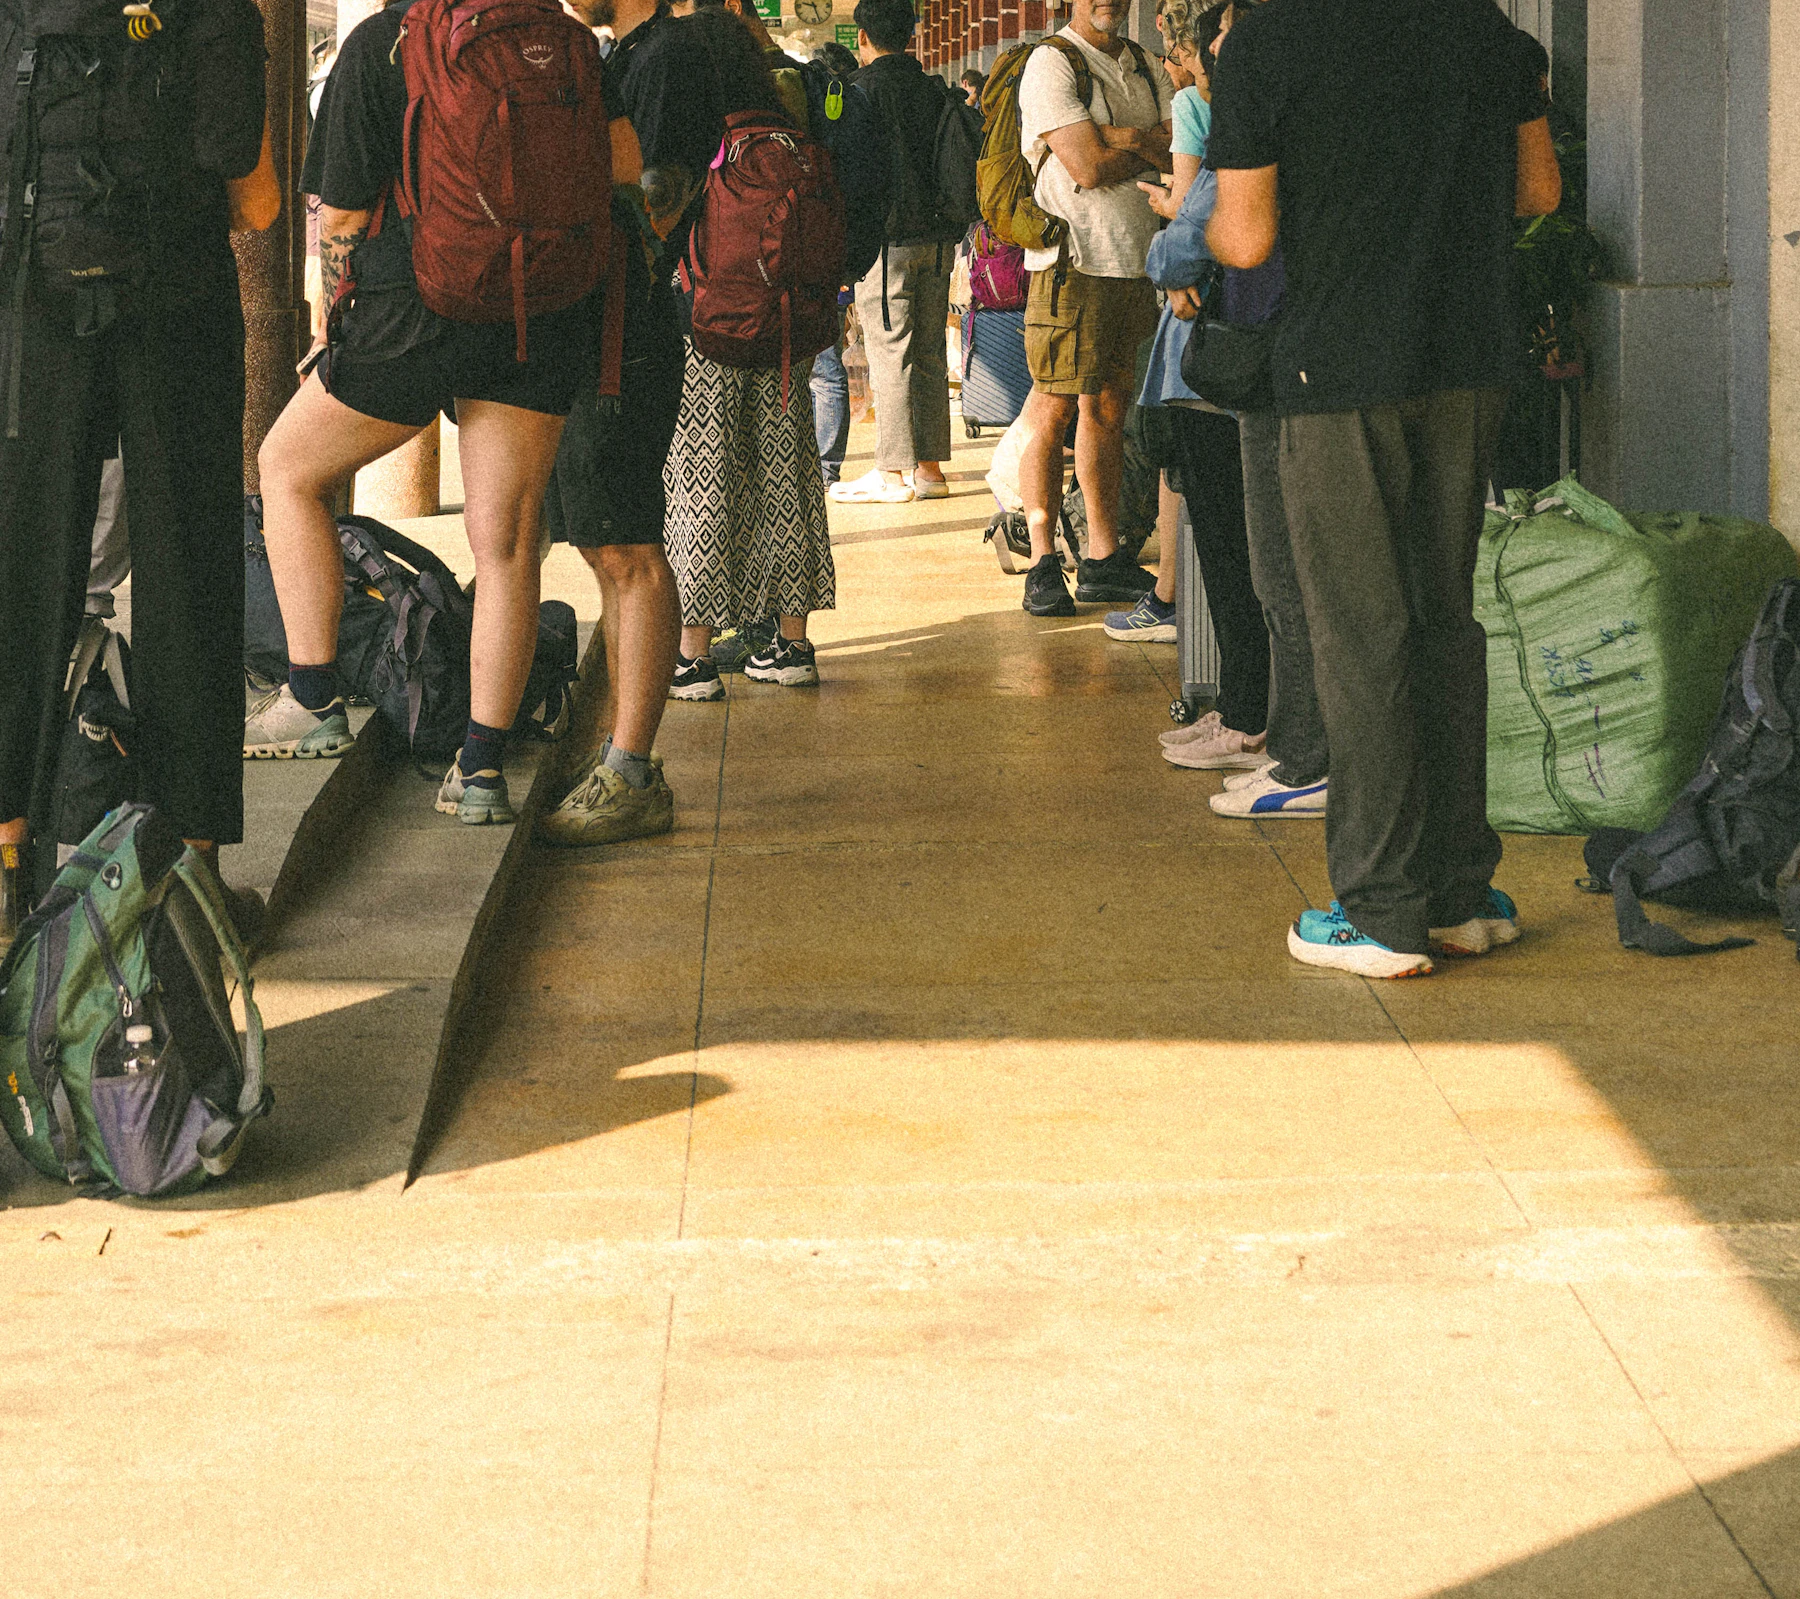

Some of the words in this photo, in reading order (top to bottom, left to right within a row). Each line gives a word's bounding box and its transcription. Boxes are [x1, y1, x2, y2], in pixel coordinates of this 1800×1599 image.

[522, 44, 553, 55] OSPREY
[475, 192, 496, 220] FAIRVIEW
[1327, 926, 1365, 944] HOKA
